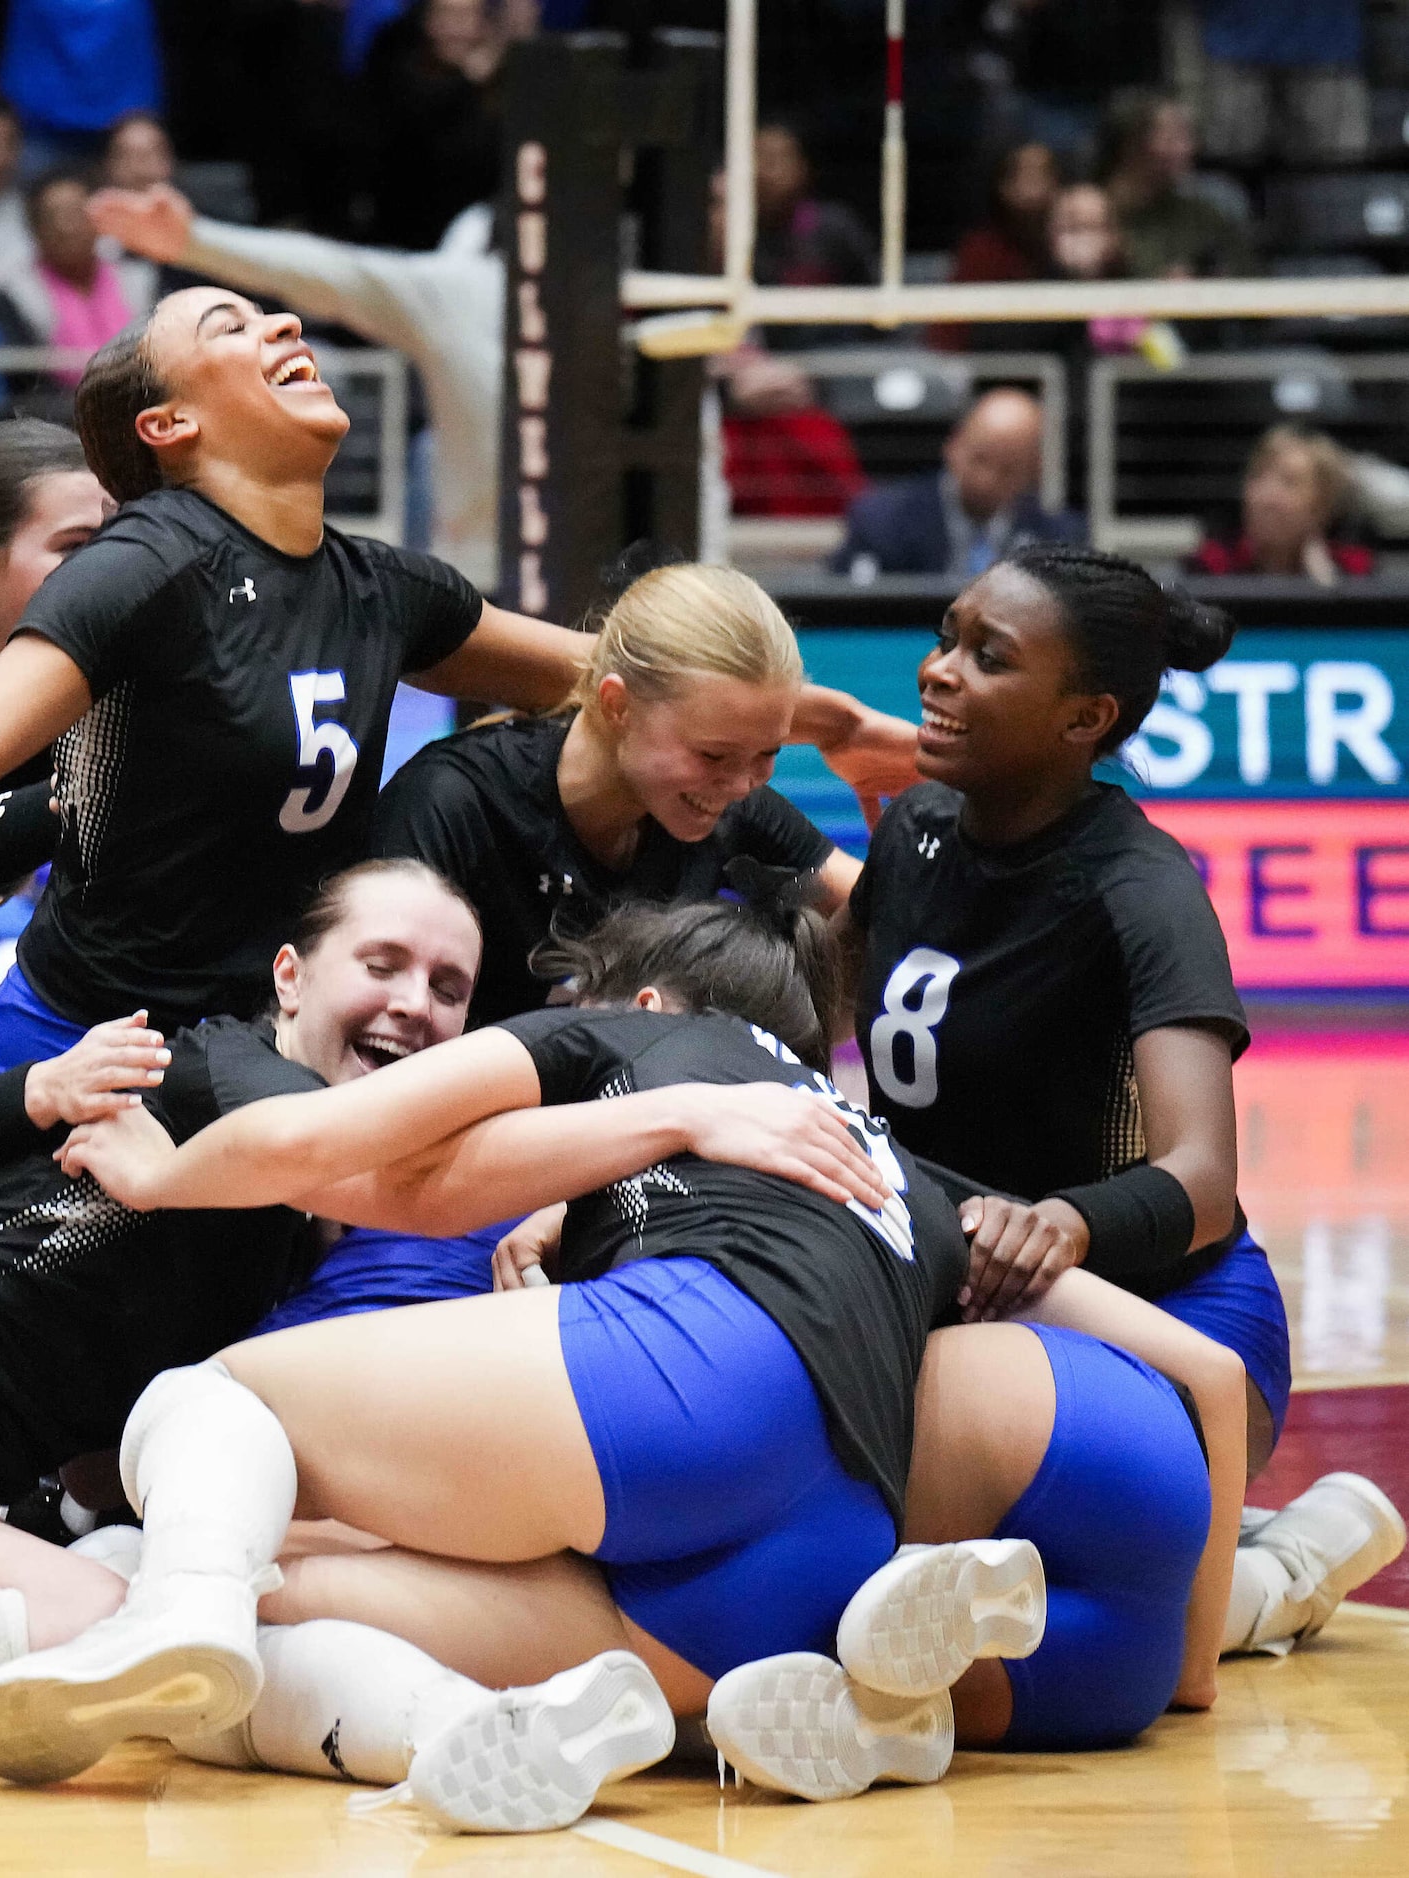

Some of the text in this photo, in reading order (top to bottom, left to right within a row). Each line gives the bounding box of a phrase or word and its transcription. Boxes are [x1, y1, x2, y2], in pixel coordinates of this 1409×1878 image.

[278, 668, 359, 833] 5
[1121, 660, 1402, 788] STR
[1187, 846, 1409, 937] EE
[870, 944, 963, 1109] 8
